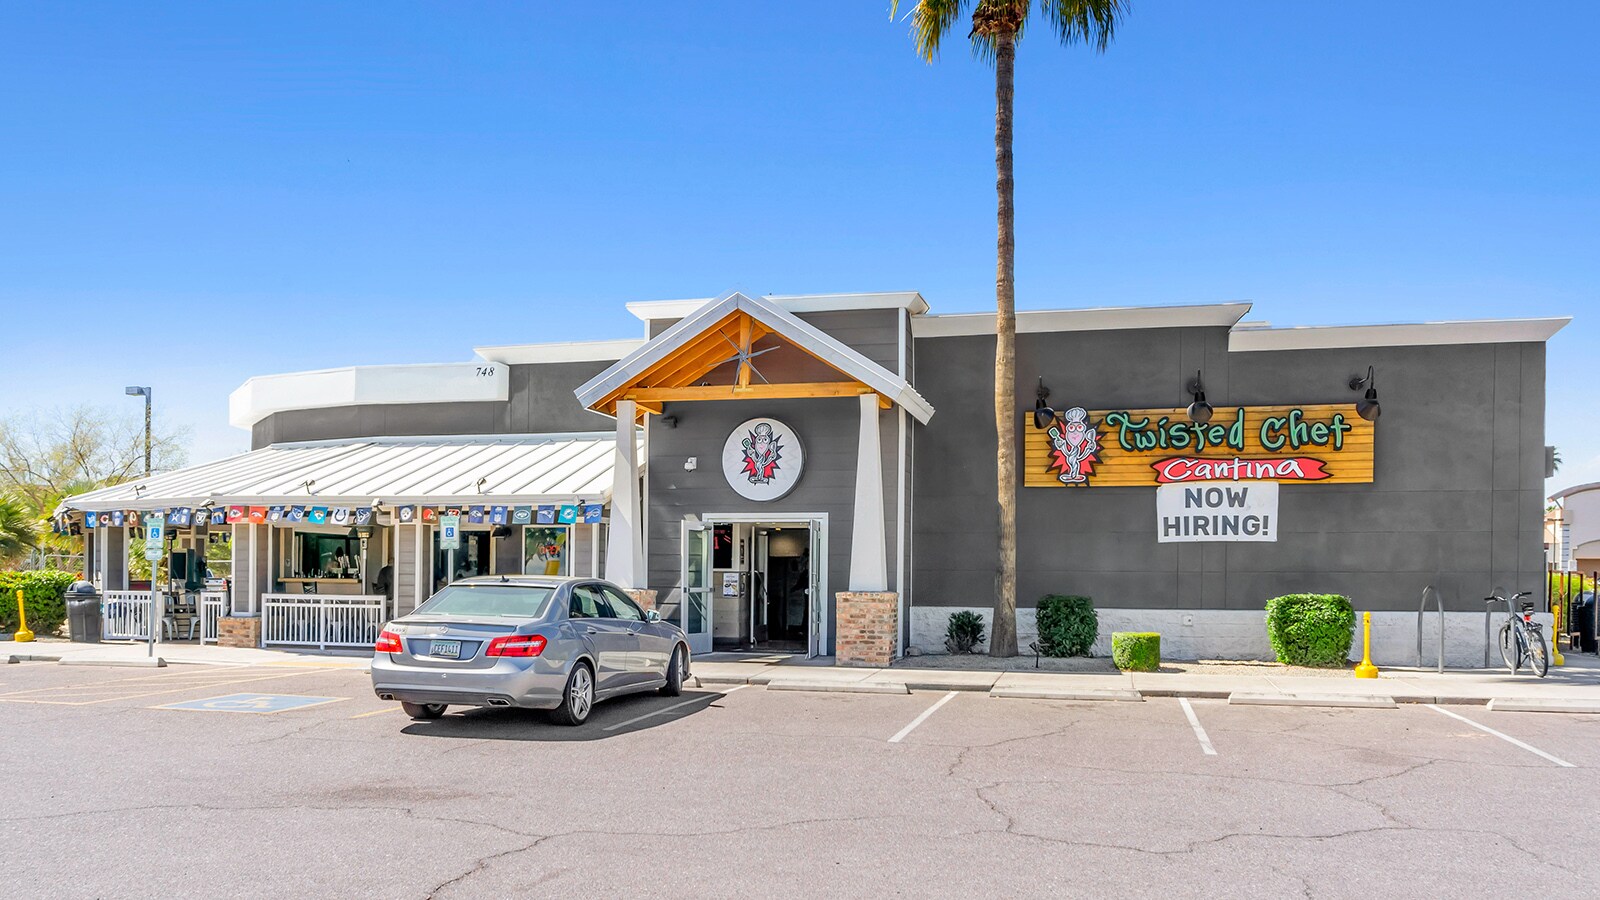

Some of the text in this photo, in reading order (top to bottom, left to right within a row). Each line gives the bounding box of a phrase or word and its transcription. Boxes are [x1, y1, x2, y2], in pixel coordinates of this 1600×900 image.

[476, 366, 495, 377] 748
[1106, 408, 1351, 452] Twisted Chef
[1163, 457, 1305, 480] Cantina
[1185, 487, 1249, 509] NOW
[1163, 514, 1269, 537] HIRING!
